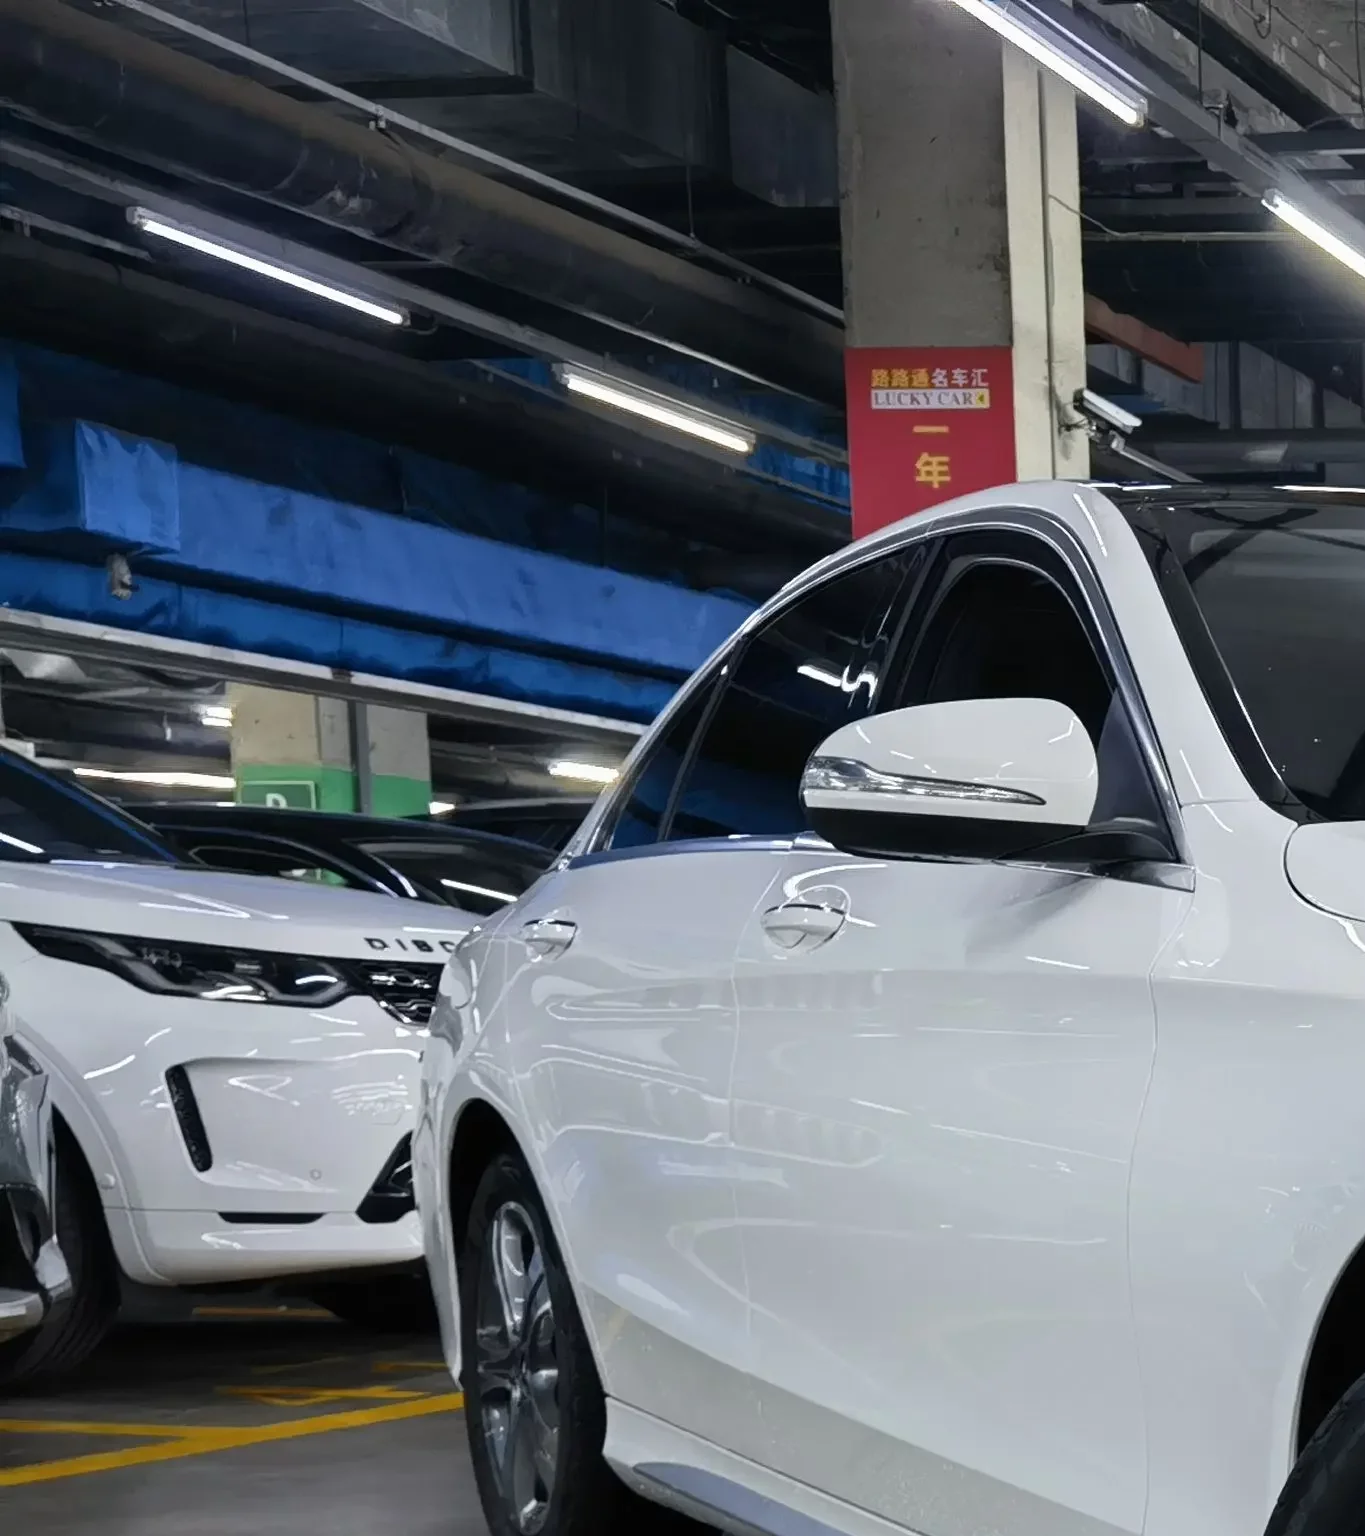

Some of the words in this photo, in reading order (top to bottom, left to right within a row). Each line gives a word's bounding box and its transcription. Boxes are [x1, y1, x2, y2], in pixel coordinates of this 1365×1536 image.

[871, 368, 989, 388] 路路通名车汇
[874, 391, 934, 406] LUCKY
[937, 391, 974, 406] CAR
